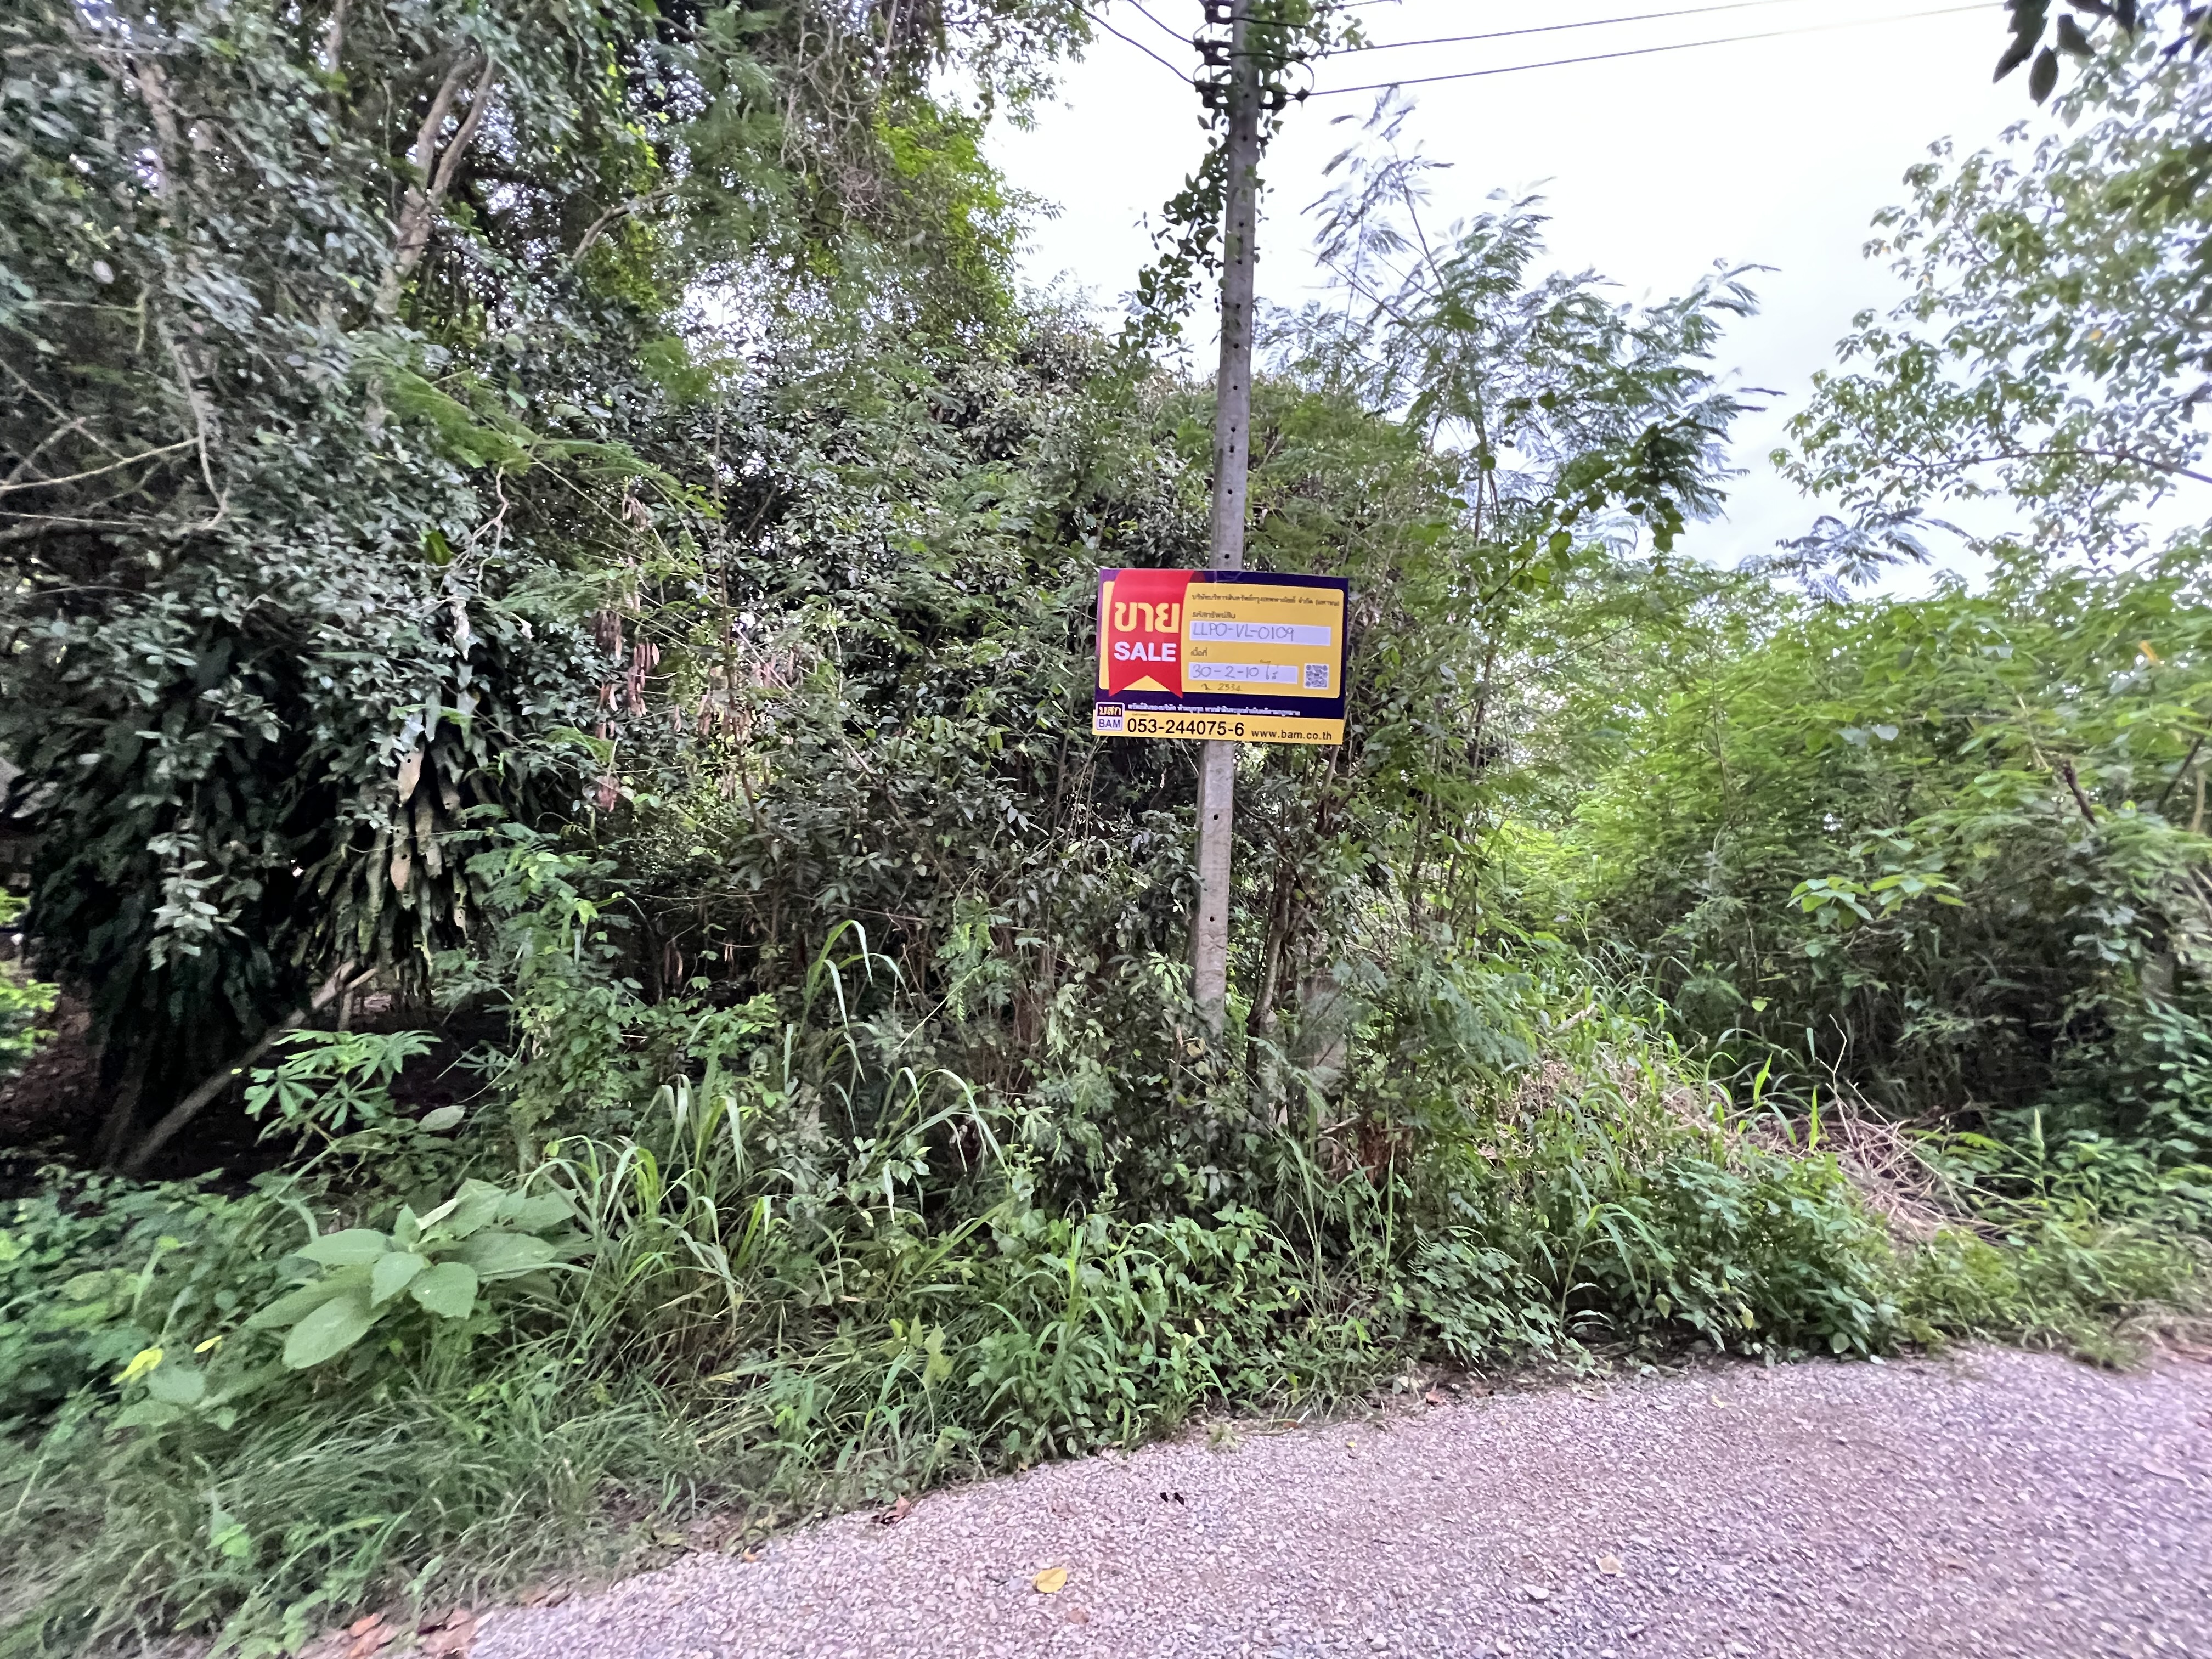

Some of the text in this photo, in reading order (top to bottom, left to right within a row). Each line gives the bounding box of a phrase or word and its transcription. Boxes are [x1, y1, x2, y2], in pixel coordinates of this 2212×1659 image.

[1114, 602, 1180, 633] ขาย
[1193, 622, 1294, 641] LLPO-VL-0109
[1114, 641, 1177, 662] SALE
[1193, 664, 1259, 678] 30-2-10
[1099, 706, 1121, 716] บสก
[1098, 719, 1121, 729] BAM
[1127, 718, 1244, 737] 053-244075-6
[1251, 729, 1332, 740] www.bam.co.th
